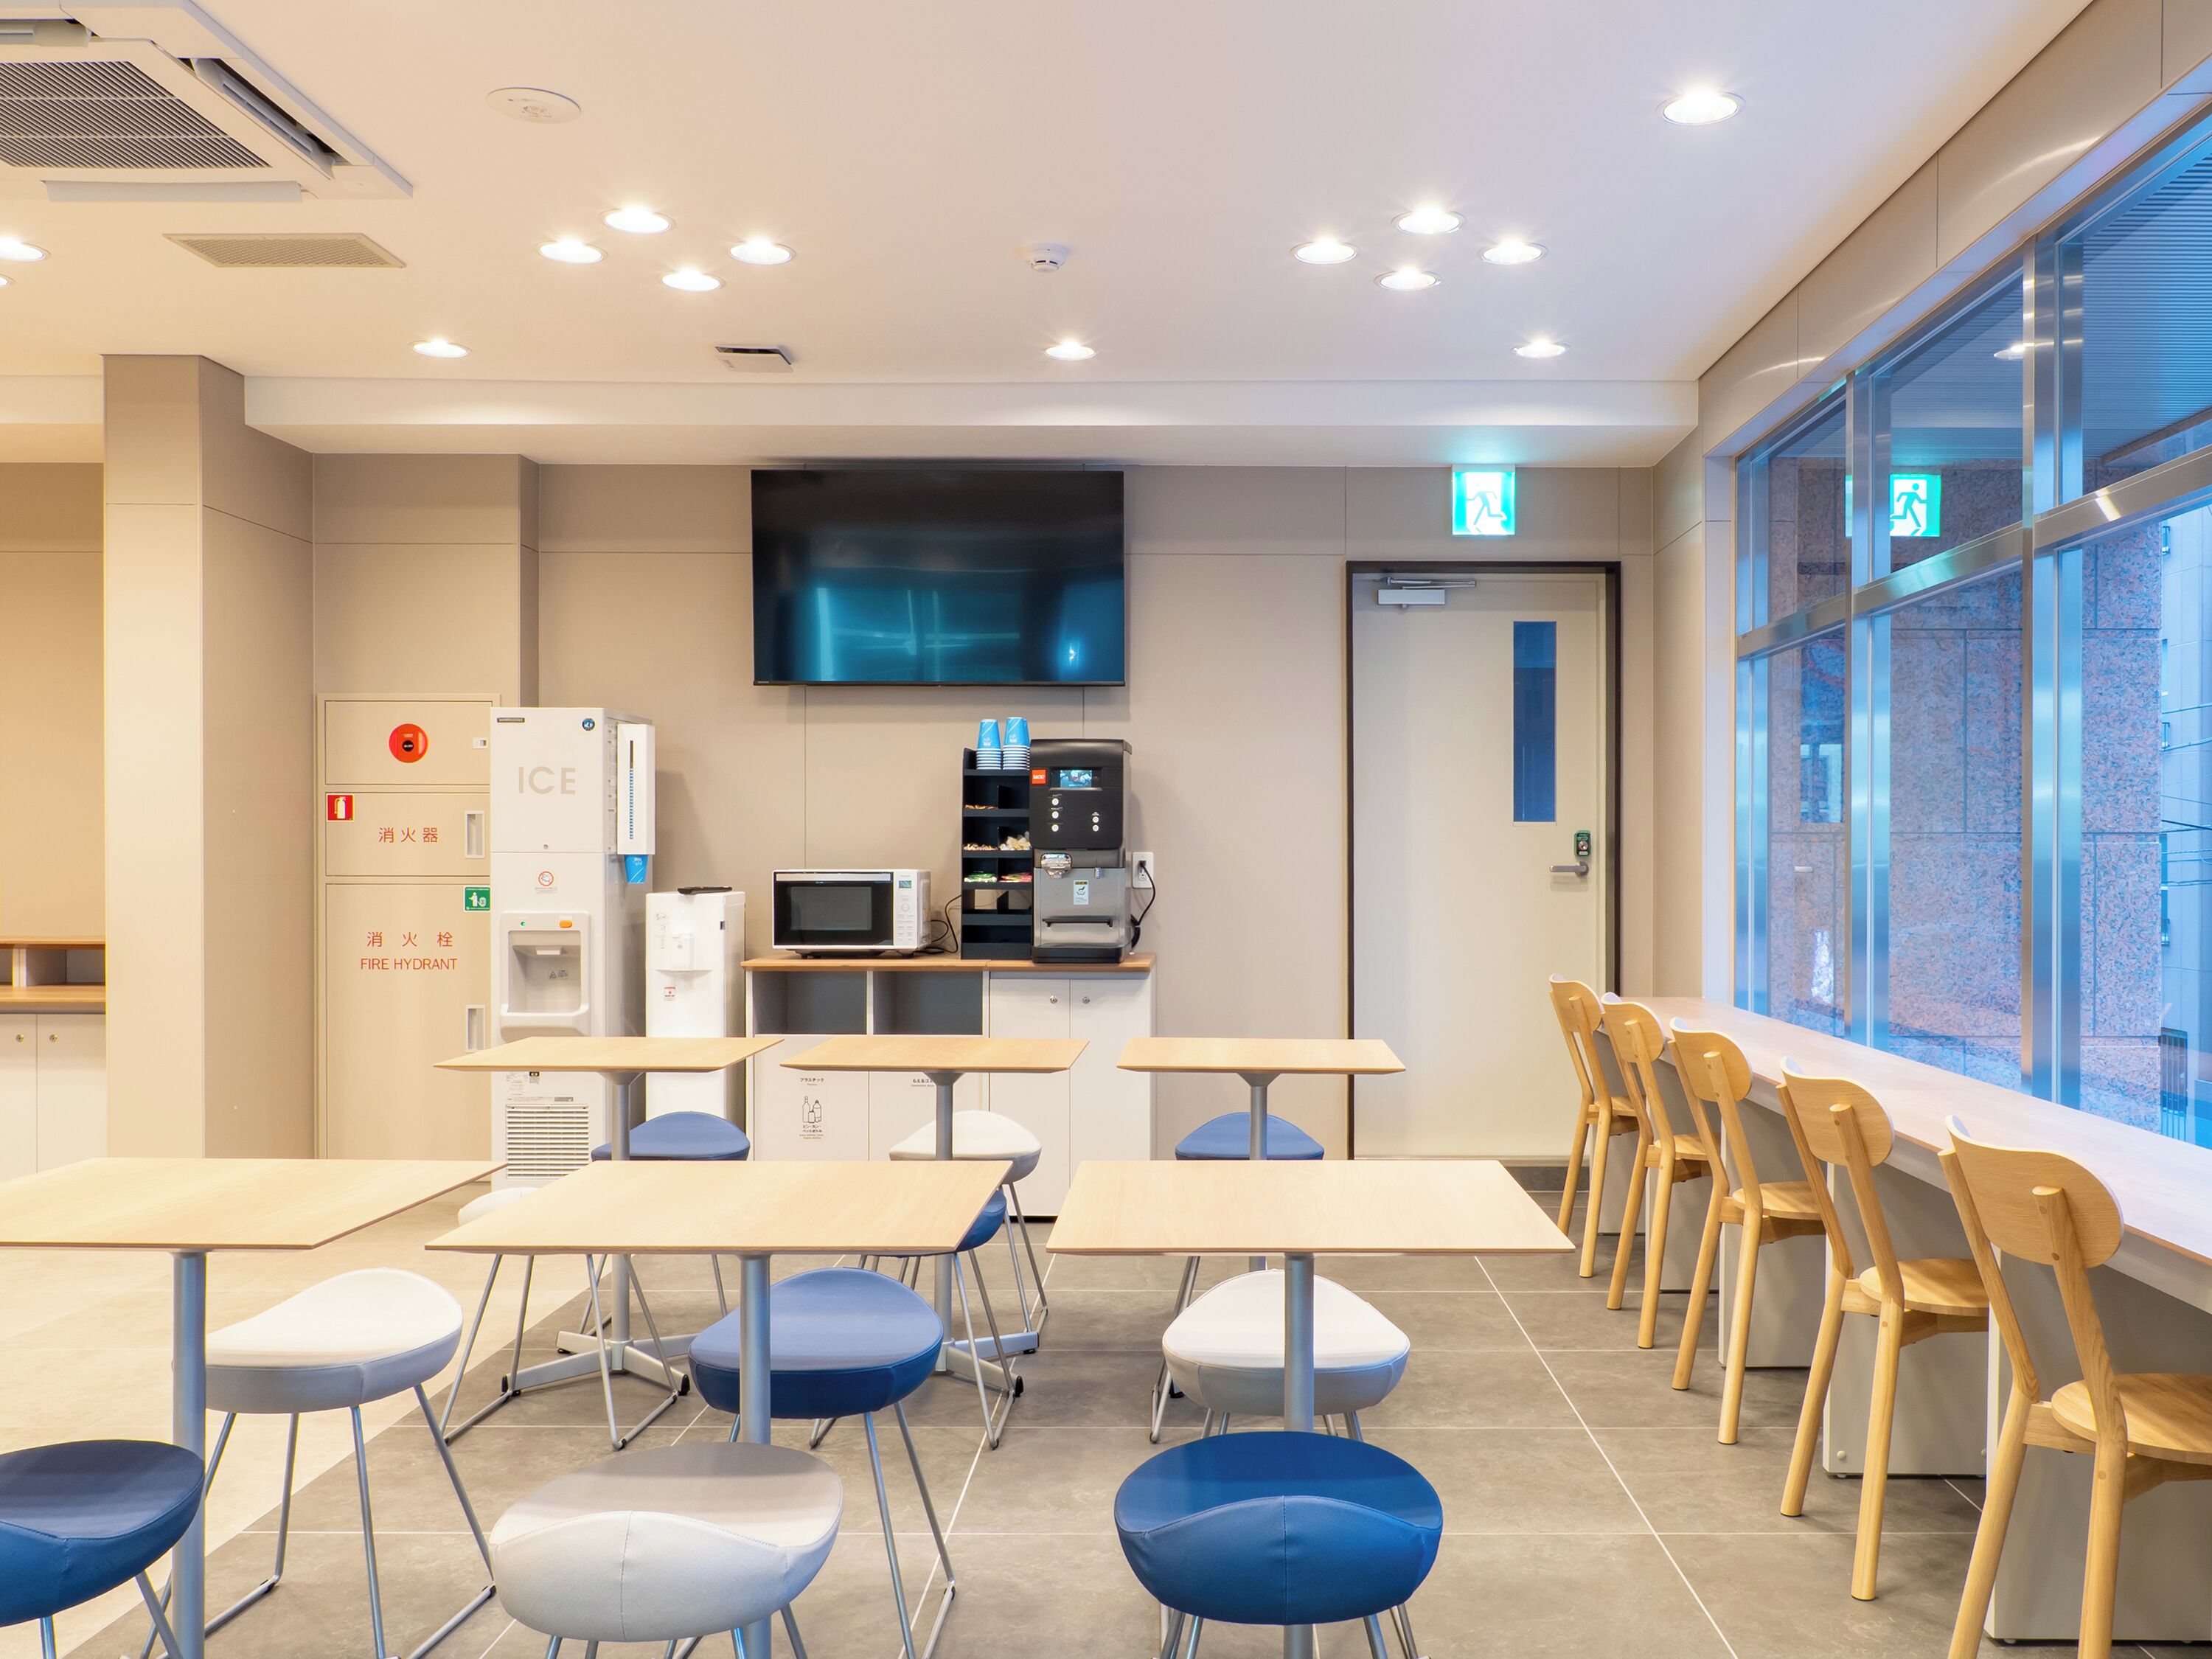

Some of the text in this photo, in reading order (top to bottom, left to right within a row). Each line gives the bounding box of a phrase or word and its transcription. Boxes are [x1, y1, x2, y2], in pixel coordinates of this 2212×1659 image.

[518, 766, 577, 795] ICE
[378, 827, 439, 844] 消火器
[366, 931, 453, 948] 消火栓
[361, 958, 458, 970] FIRE HYDRANT
